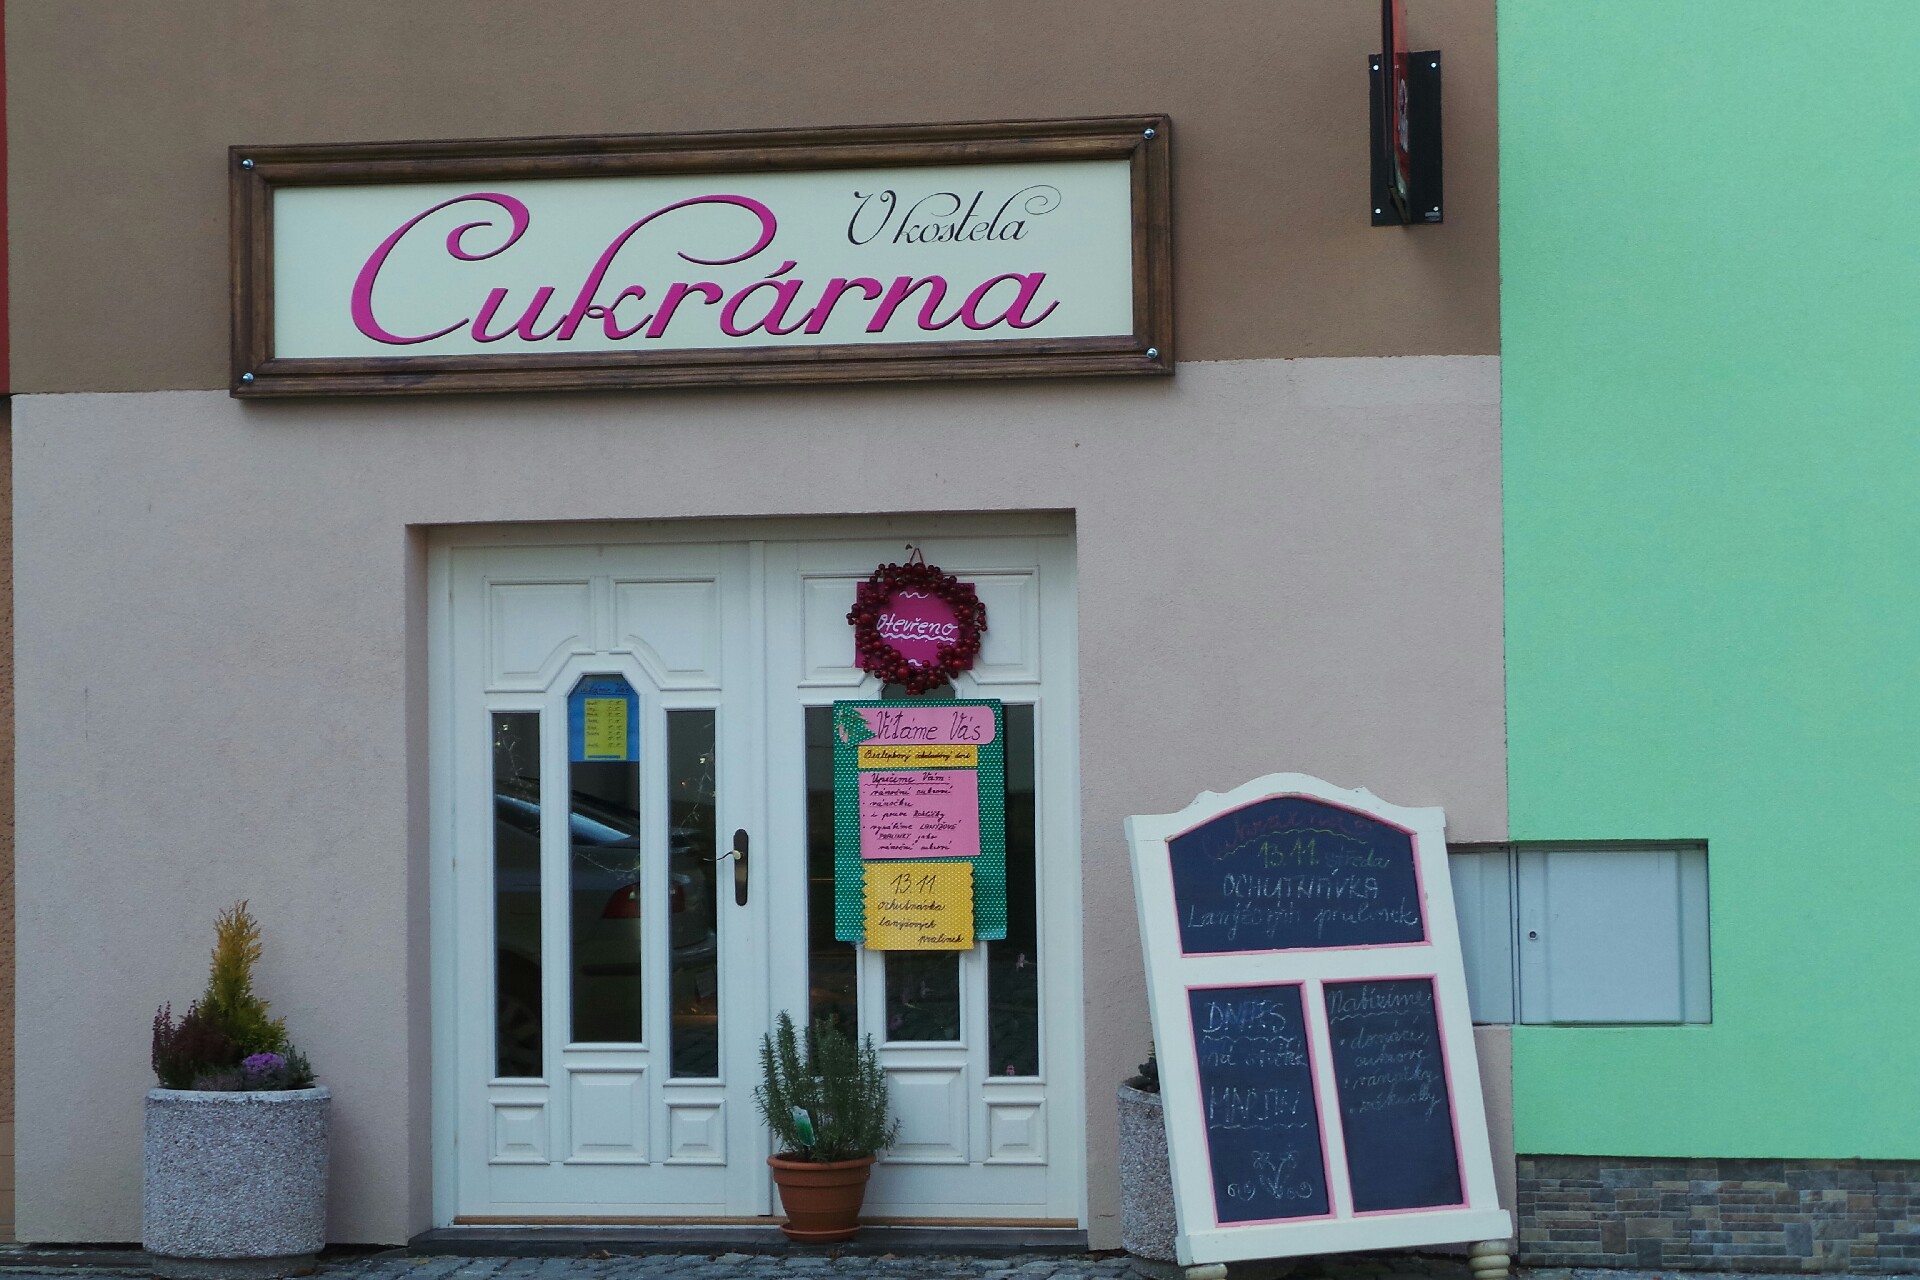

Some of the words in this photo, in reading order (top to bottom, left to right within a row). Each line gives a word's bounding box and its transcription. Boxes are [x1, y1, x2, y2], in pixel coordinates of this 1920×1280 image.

[892, 185, 1062, 244] kostela
[351, 192, 1060, 346] Cukrárna
[876, 613, 958, 636] Otevřeno
[949, 710, 982, 741] Vás
